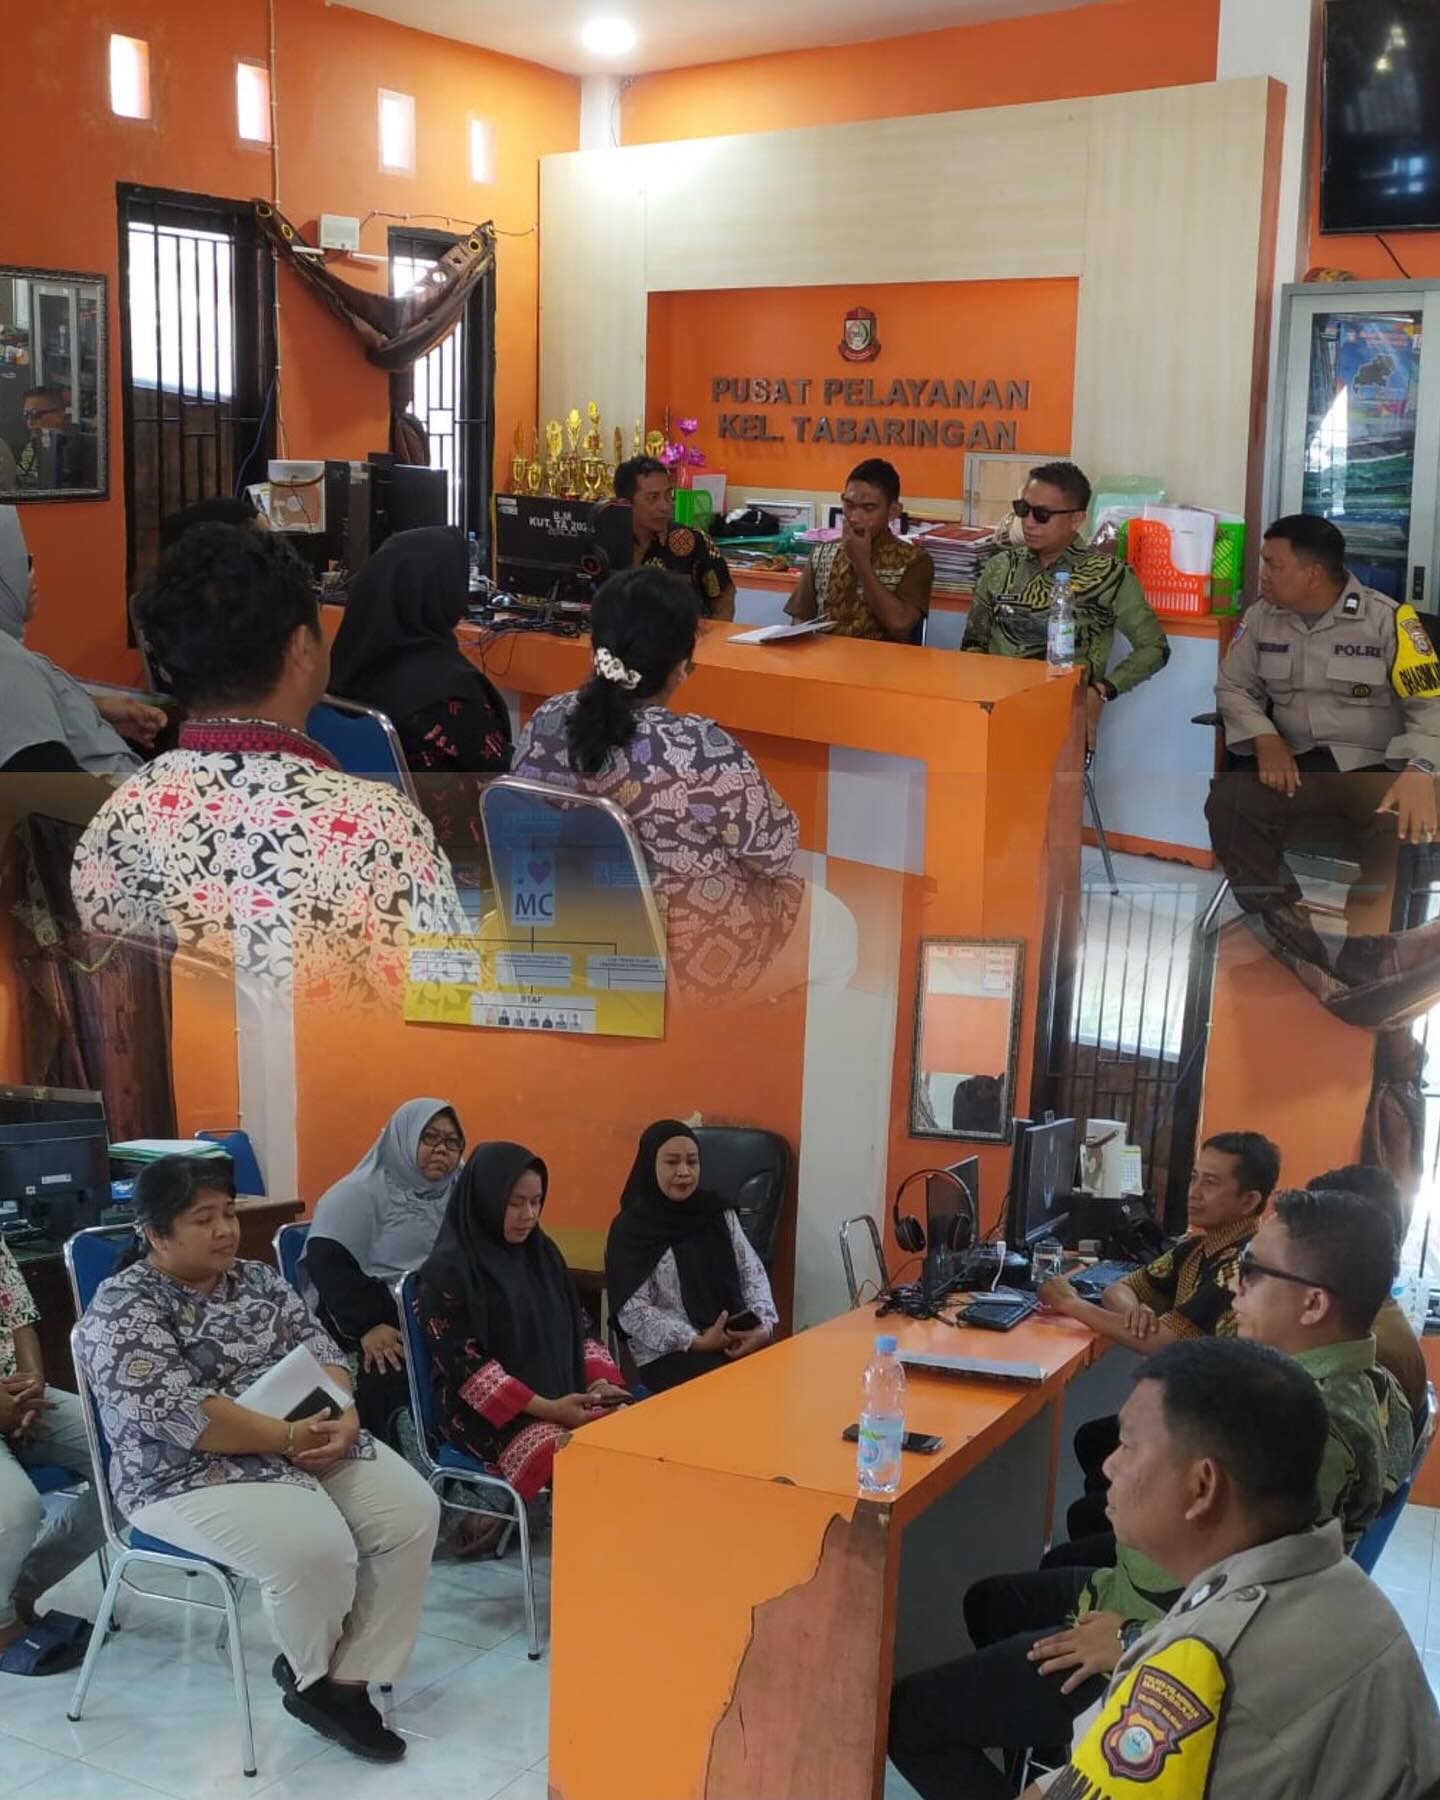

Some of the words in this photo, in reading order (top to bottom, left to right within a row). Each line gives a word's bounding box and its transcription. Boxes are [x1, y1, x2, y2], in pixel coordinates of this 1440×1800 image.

[711, 376, 811, 404] PUSAT
[824, 378, 1031, 410] PELAYANAN
[718, 414, 784, 442] KEL.
[792, 416, 1018, 450] TABARINGAN
[515, 893, 553, 916] MC
